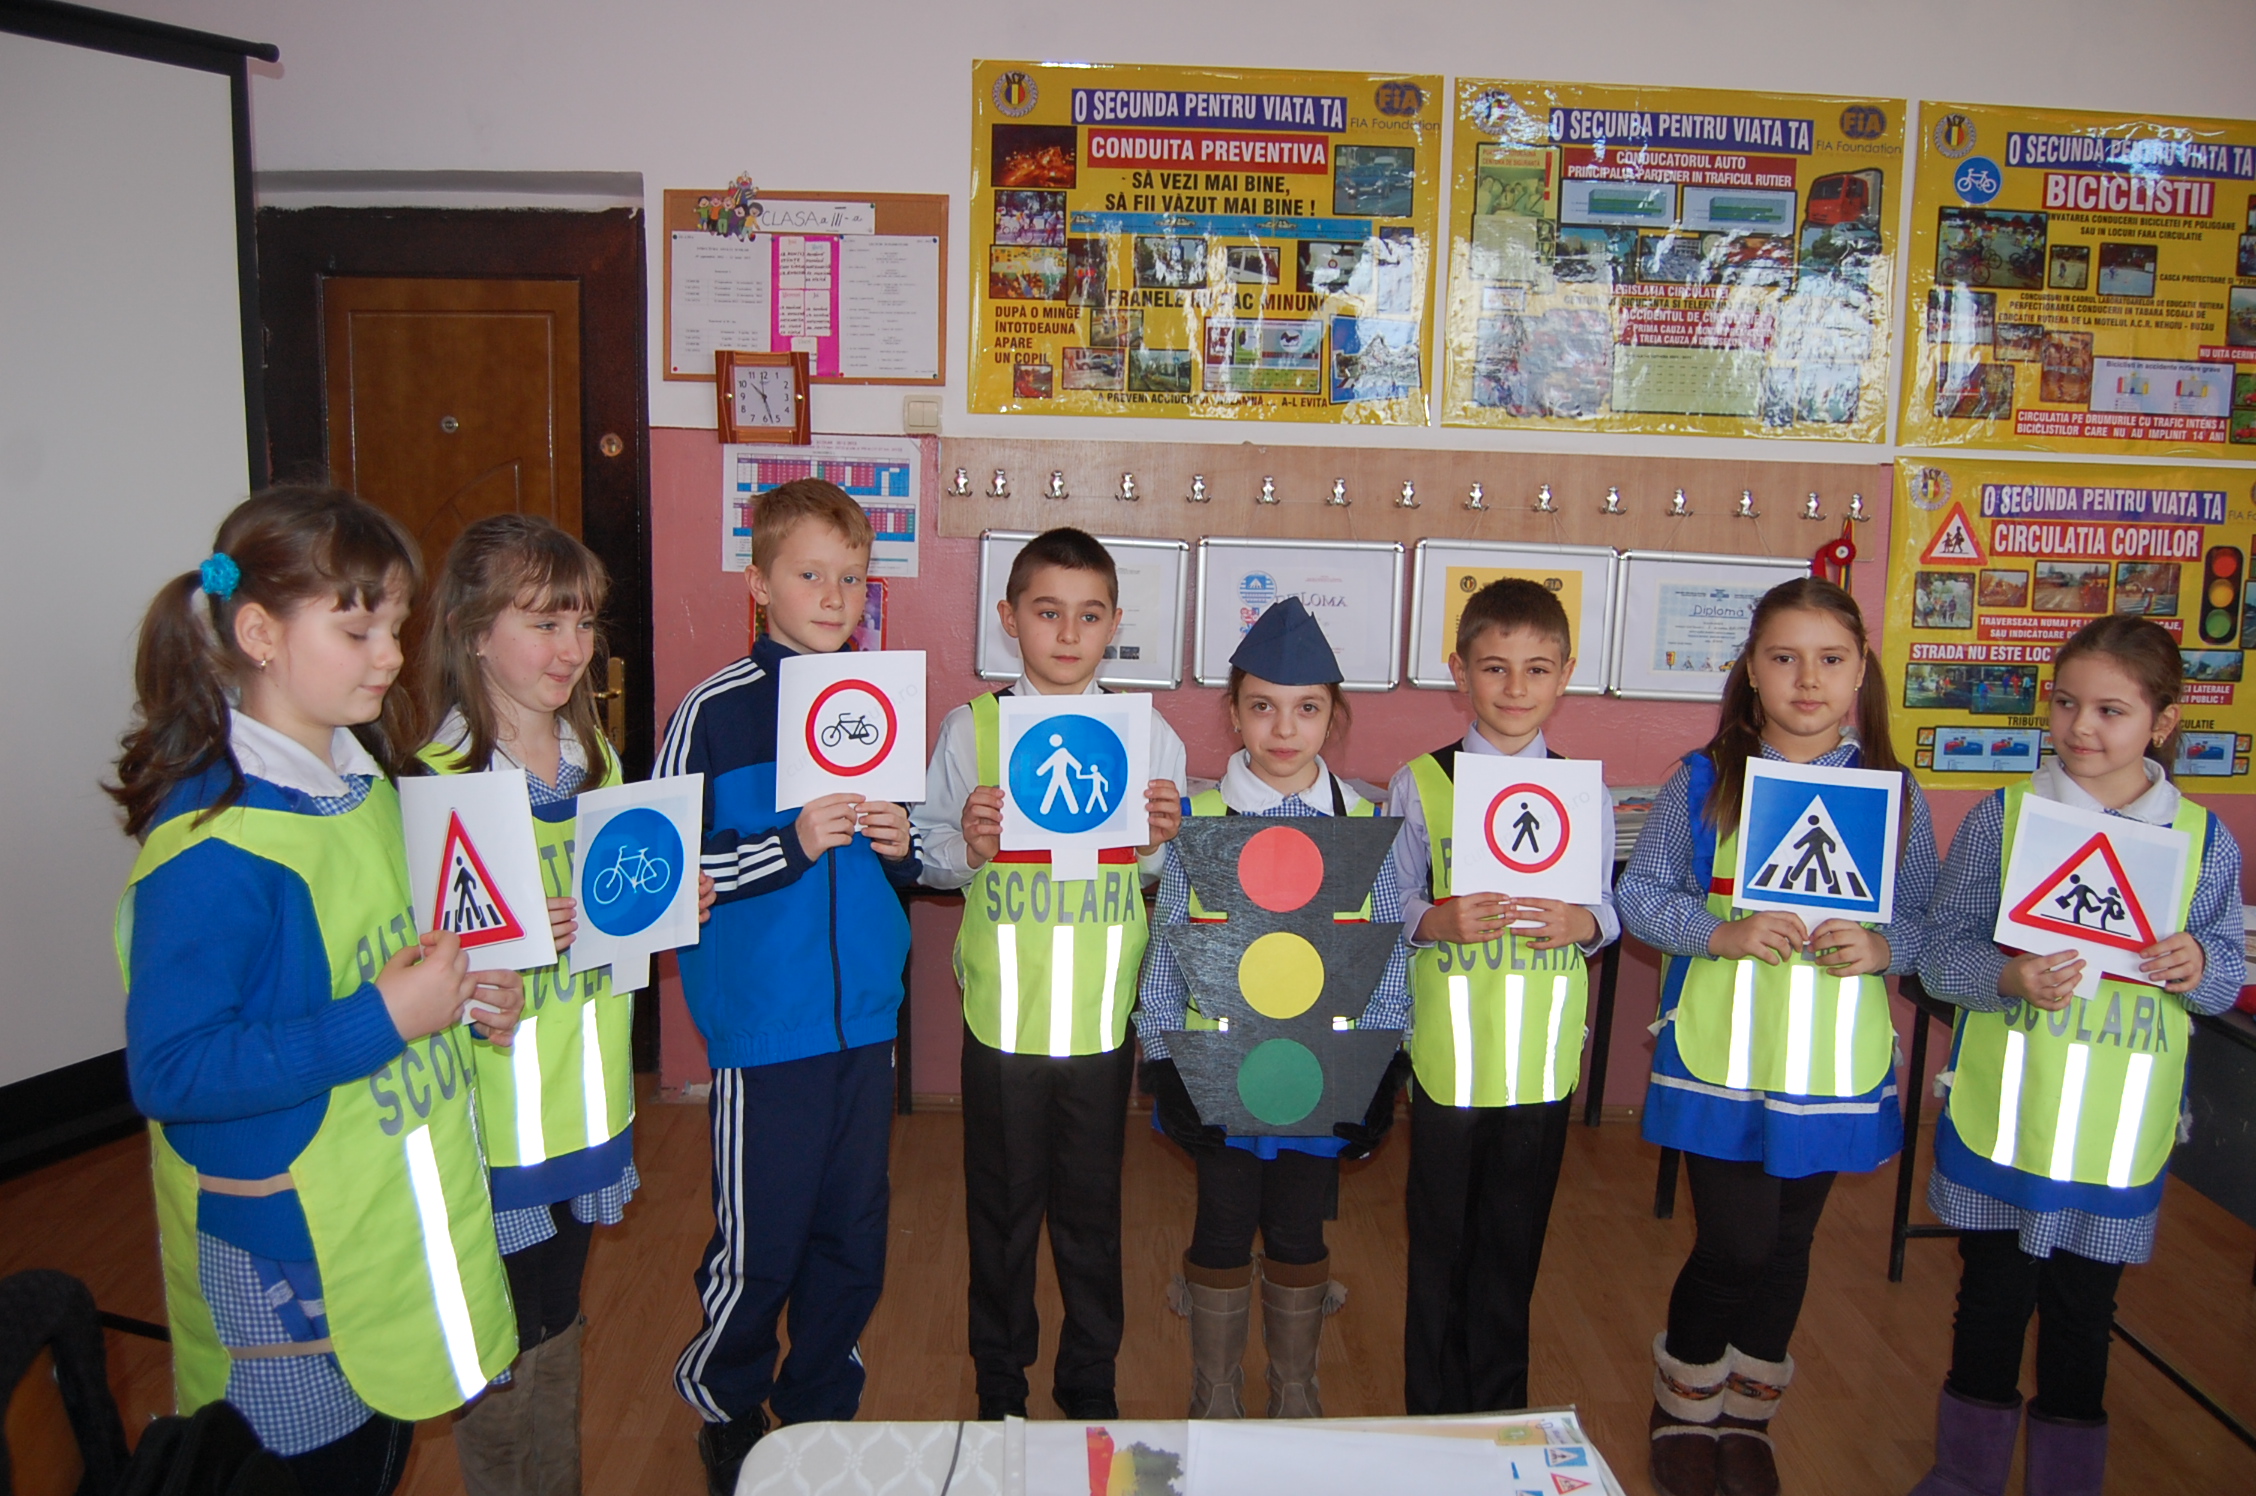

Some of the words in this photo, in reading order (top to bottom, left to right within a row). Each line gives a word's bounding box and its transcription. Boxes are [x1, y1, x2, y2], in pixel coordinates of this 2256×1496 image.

[1075, 90, 1088, 123] O
[1093, 90, 1179, 121] SECUNDA
[1185, 93, 1257, 120] PENTRU
[1263, 95, 1316, 126] VIATA
[1321, 98, 1343, 129] TA
[1351, 117, 1368, 128] FIA
[1552, 109, 1564, 141] O
[1570, 110, 1653, 140] SECUNDA
[1659, 113, 1728, 141] PENTRU
[1733, 117, 1783, 147] VIATA
[1788, 121, 1809, 151] TA
[1091, 136, 1195, 161] CONDUITA
[1201, 140, 1326, 165] PREVENTIVA
[1816, 140, 1833, 151] FIA
[1837, 141, 1902, 154] Foundation
[1616, 151, 1711, 169] CONDUCATORUL
[1714, 156, 1746, 170] AUTO
[2008, 133, 2021, 166] O
[2025, 134, 2105, 164] SECUNDA
[2233, 146, 2253, 177] TA
[1160, 172, 1198, 190] VEZI
[1205, 174, 1238, 192] MAI
[1245, 175, 1290, 196] BINE,
[1638, 169, 1690, 184] PARTENER
[1692, 172, 1703, 183] IN
[1705, 172, 1753, 186] TRAFICUL
[1755, 173, 1792, 187] RUTIER
[2045, 173, 2211, 216] BICICLISTII
[1133, 194, 1155, 211] FII
[1224, 197, 1257, 214] MAI
[1263, 198, 1303, 216] BINE
[762, 210, 820, 227] CLASA
[2182, 220, 2193, 229] PE
[2080, 226, 2096, 236] SAU
[2108, 228, 2136, 238] LOCURI
[2137, 229, 2157, 240] FARA
[2159, 231, 2203, 242] CIRCULATIE
[1031, 306, 1039, 318] O
[1043, 307, 1081, 319] MINGE
[994, 337, 1033, 348] APARE
[994, 352, 1010, 363] UN
[1015, 353, 1049, 364] COPIL
[749, 371, 756, 379] 11
[760, 371, 769, 380] 12
[775, 371, 779, 379] 1
[739, 380, 748, 389] 10
[783, 380, 789, 390] 2
[740, 392, 746, 401] 9
[784, 393, 789, 402] 3
[1301, 397, 1328, 408] EVITA
[741, 405, 746, 414] 8
[784, 406, 790, 414] 4
[750, 413, 756, 423] 7
[762, 414, 769, 423] 6
[775, 414, 781, 423] 5
[2018, 410, 2069, 424] CIRCULATIA
[2071, 413, 2083, 424] PE
[2085, 414, 2136, 427] DRUMURILE
[2138, 417, 2151, 427] CU
[2153, 417, 2184, 428] TRAFIC
[2186, 418, 2218, 430] INTENS
[2218, 420, 2226, 430] A
[2016, 423, 2079, 436] BICICLISTILOR
[2084, 426, 2108, 437] CARE
[2113, 427, 2126, 437] NU
[2131, 428, 2144, 438] AU
[2148, 429, 2187, 440] IMPLINIT
[2193, 431, 2204, 441] 14
[2208, 432, 2225, 442] ANI
[1983, 485, 1996, 516] O
[2000, 485, 2078, 515] SECUNDA
[2082, 487, 2147, 513] PENTRU
[2151, 490, 2198, 518] VIATA
[2203, 492, 2222, 521] TA
[1994, 523, 2106, 555] CIRCULATIA
[2111, 527, 2199, 558] COPIILOR
[1693, 604, 1744, 616] Diploma
[1980, 616, 2039, 627] TRAVERSEAZA
[2040, 618, 2069, 628] NUMAI
[2070, 618, 2081, 628] PE
[1990, 628, 2008, 638] SAU
[2009, 629, 2065, 640] INDICATOARE
[1912, 643, 1964, 660] STRADA
[1967, 645, 1986, 660] NU
[1990, 645, 2022, 661] ESTE
[2025, 646, 2051, 662] LOC
[2192, 685, 2230, 694] LATERALE
[2190, 695, 2218, 704] PUBLIC
[986, 870, 1135, 923] SCOLARA
